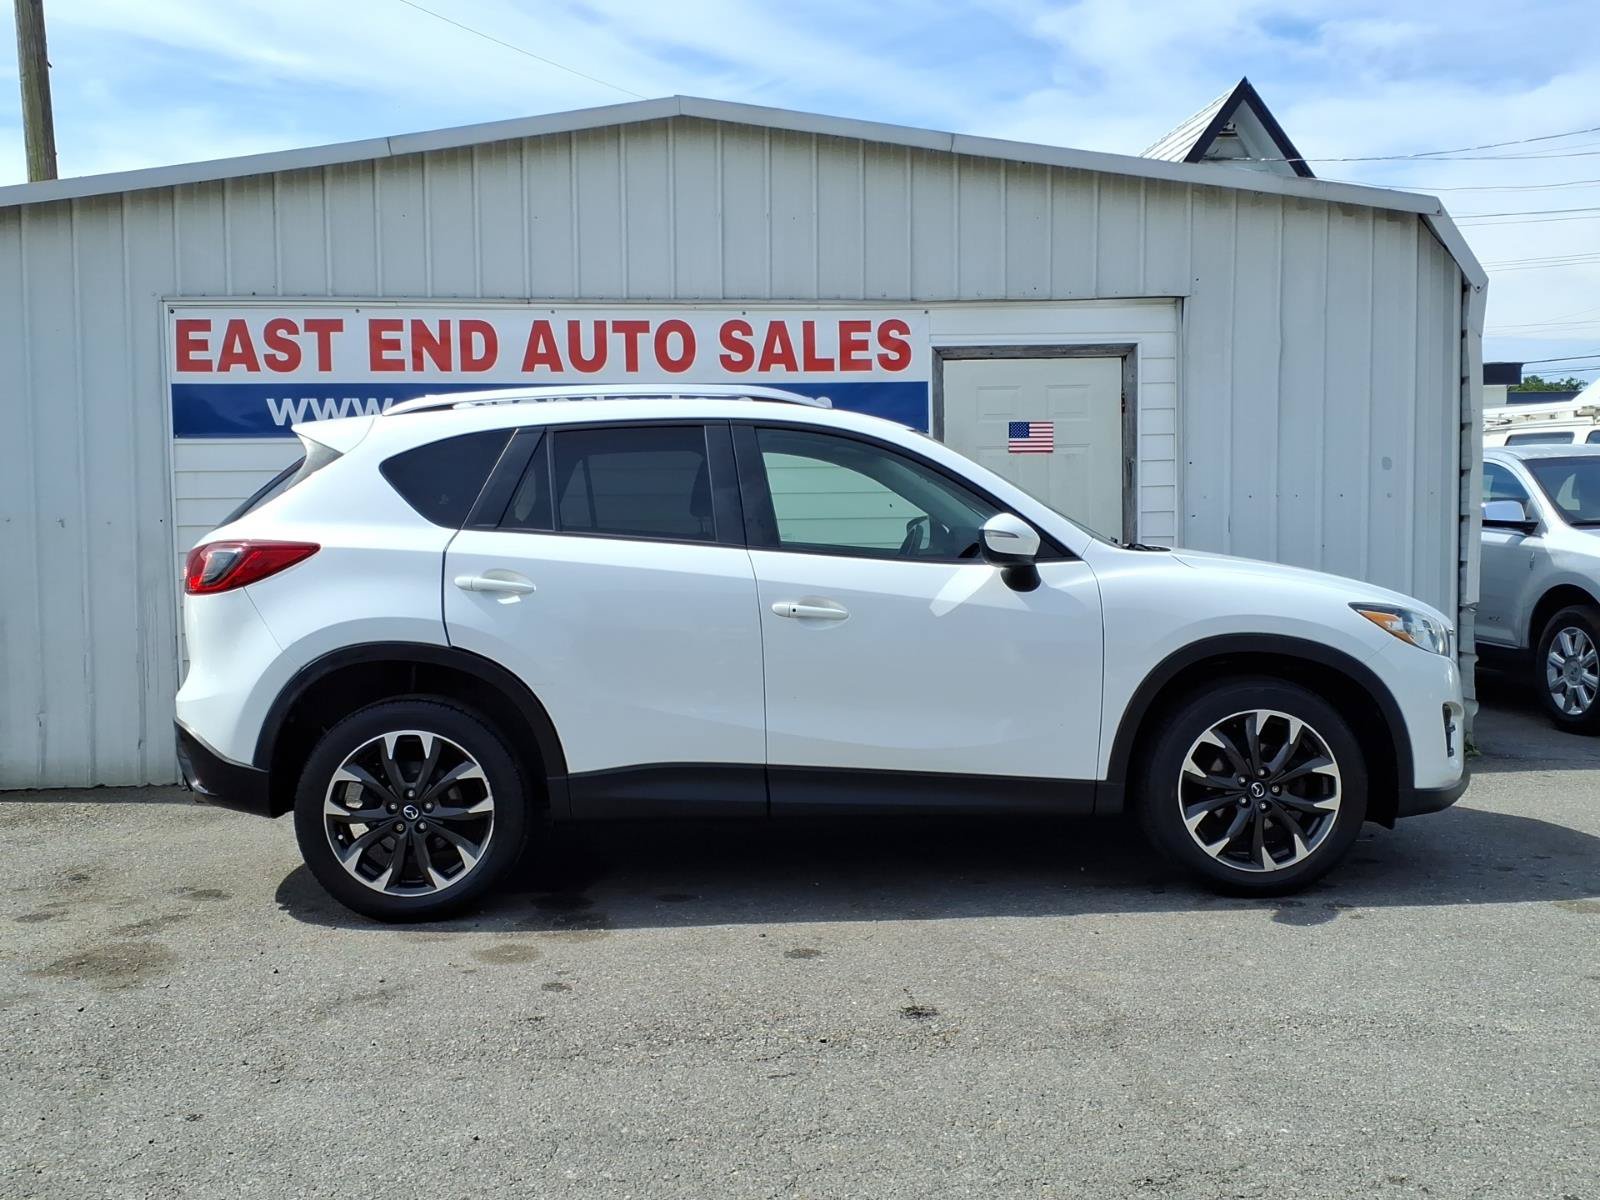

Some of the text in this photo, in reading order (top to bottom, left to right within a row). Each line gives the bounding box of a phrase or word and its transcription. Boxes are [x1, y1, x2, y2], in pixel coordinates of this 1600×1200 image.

[176, 319, 912, 373] EAST END AUTO SALES
